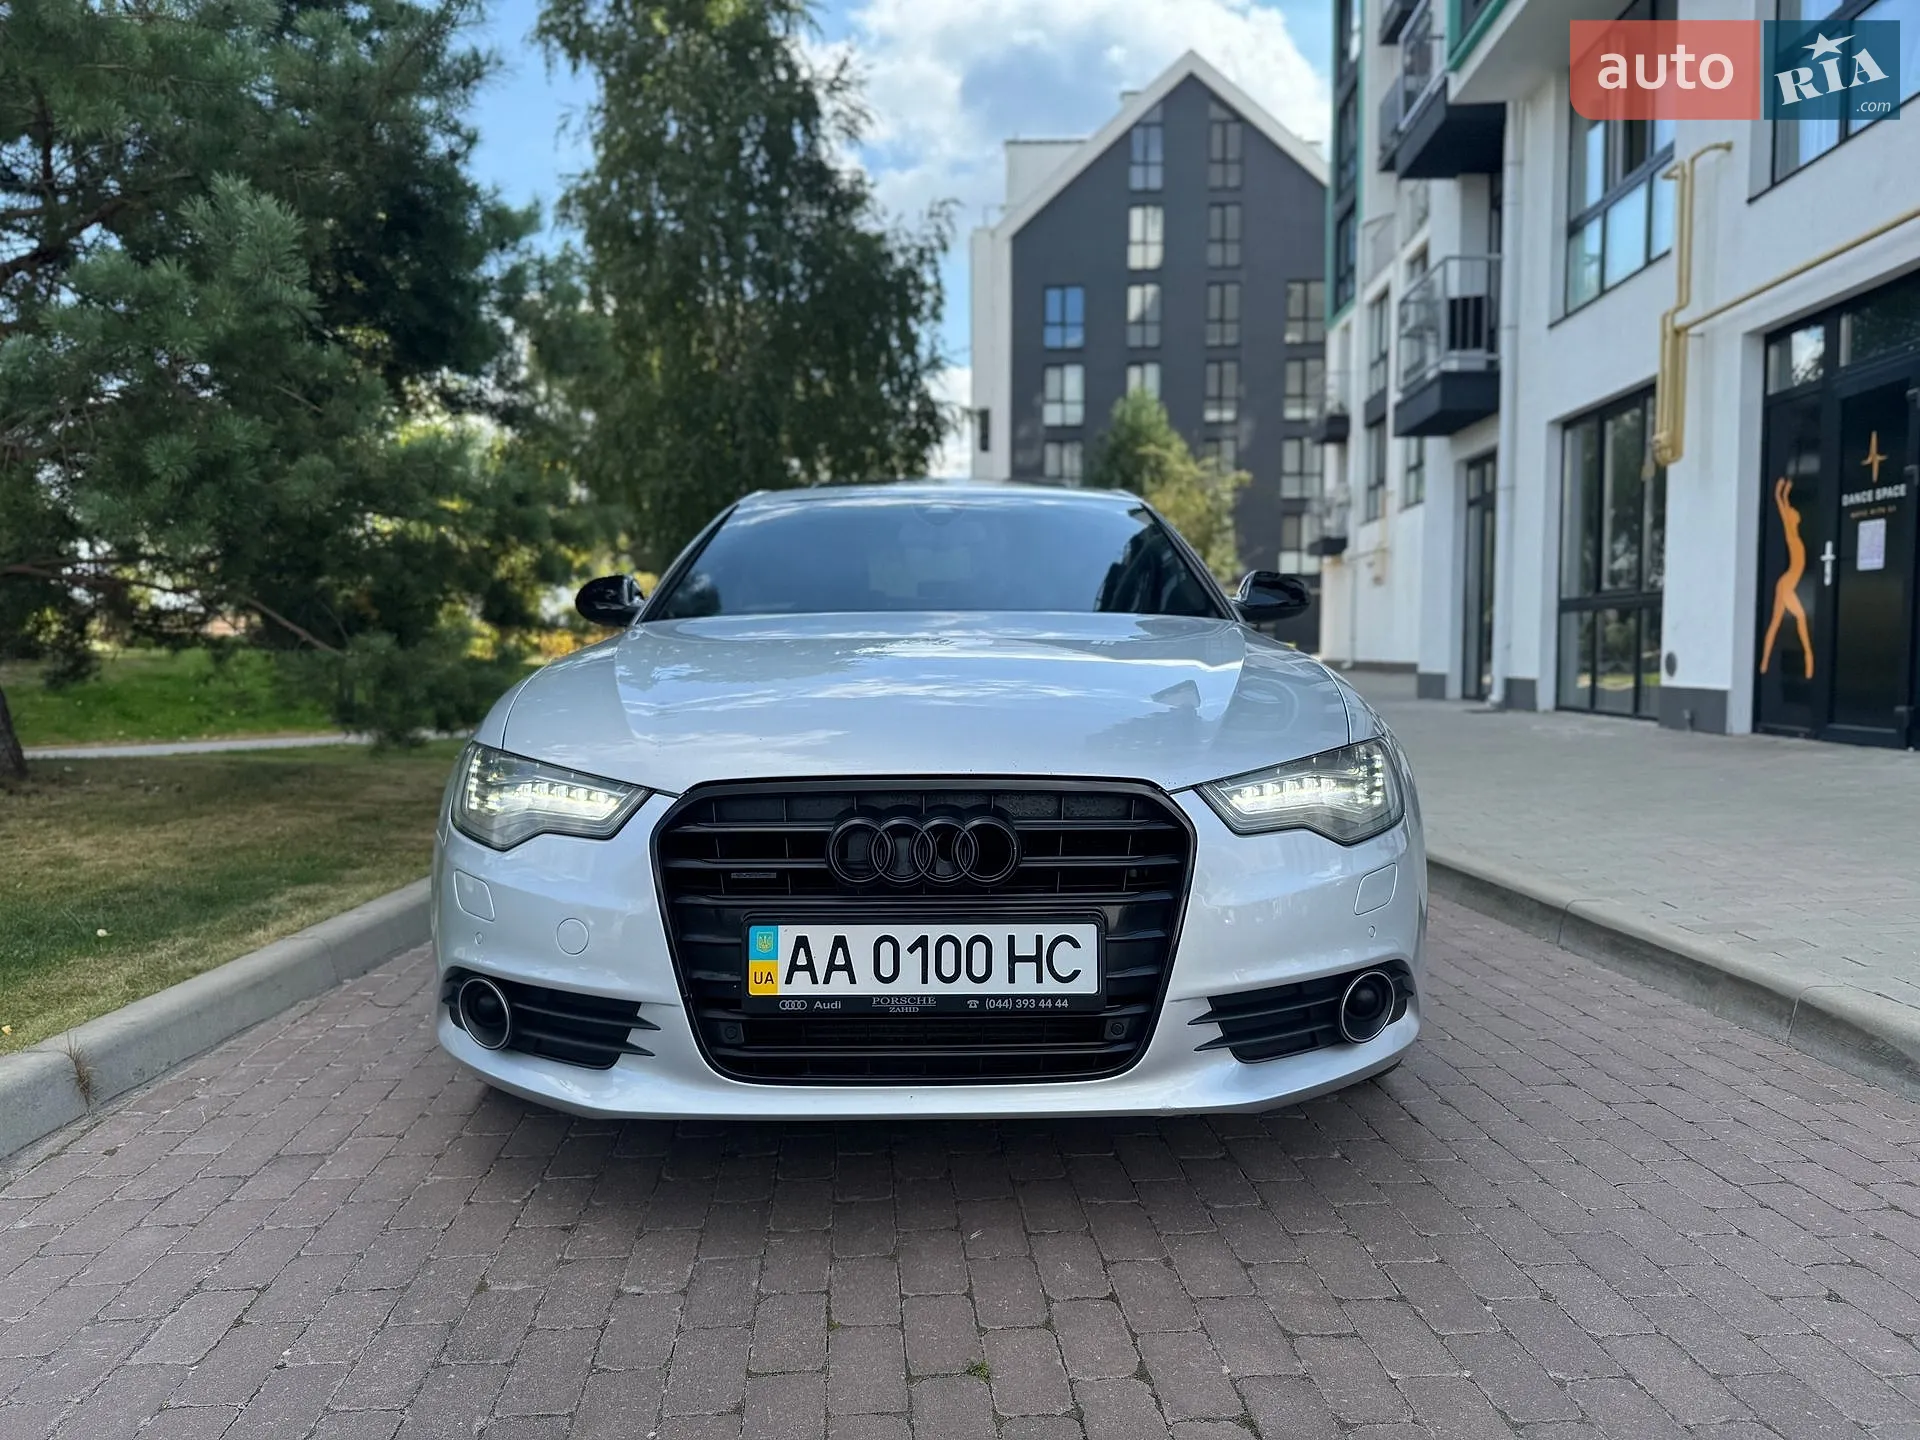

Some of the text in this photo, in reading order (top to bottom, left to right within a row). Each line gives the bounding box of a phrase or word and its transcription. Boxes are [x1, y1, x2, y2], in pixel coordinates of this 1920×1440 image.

[1842, 483, 1906, 507] DANCE SPACE
[784, 934, 1082, 985] AA 0100 HC
[753, 971, 775, 985] UA
[813, 1000, 842, 1010] Audi
[872, 996, 937, 1006] PORSCHE
[985, 998, 1069, 1010] (044) 393 44 44
